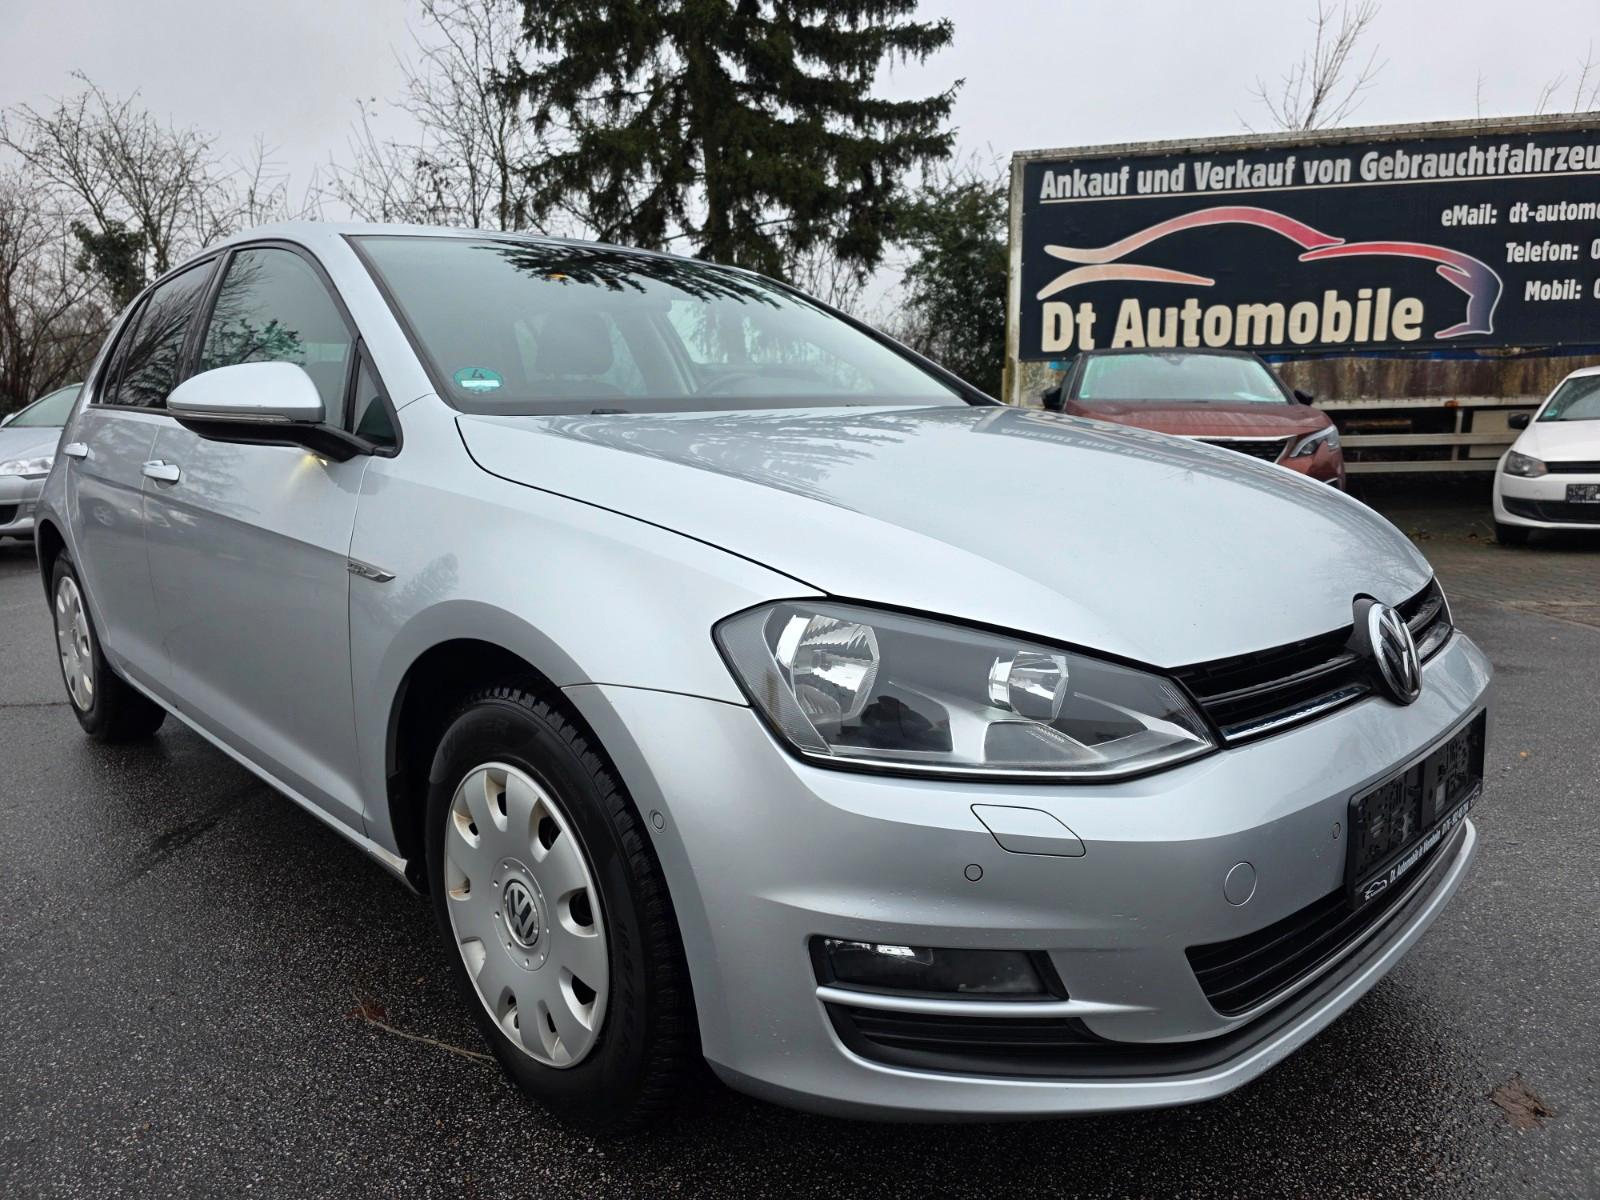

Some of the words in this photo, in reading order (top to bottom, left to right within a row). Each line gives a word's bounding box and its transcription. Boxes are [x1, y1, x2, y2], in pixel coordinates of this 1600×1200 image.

[1040, 166, 1130, 199] Ankauf
[1137, 163, 1185, 193] und
[1193, 156, 1296, 190] Verkauf
[1303, 157, 1351, 185] von
[1360, 142, 1600, 182] Gebrauchtfahrzeu
[1441, 203, 1498, 226] eMail:
[1505, 240, 1579, 263] Telefon:
[1524, 279, 1582, 302] Mobil:
[1041, 301, 1097, 353] Dt
[1111, 287, 1425, 349] Automobile
